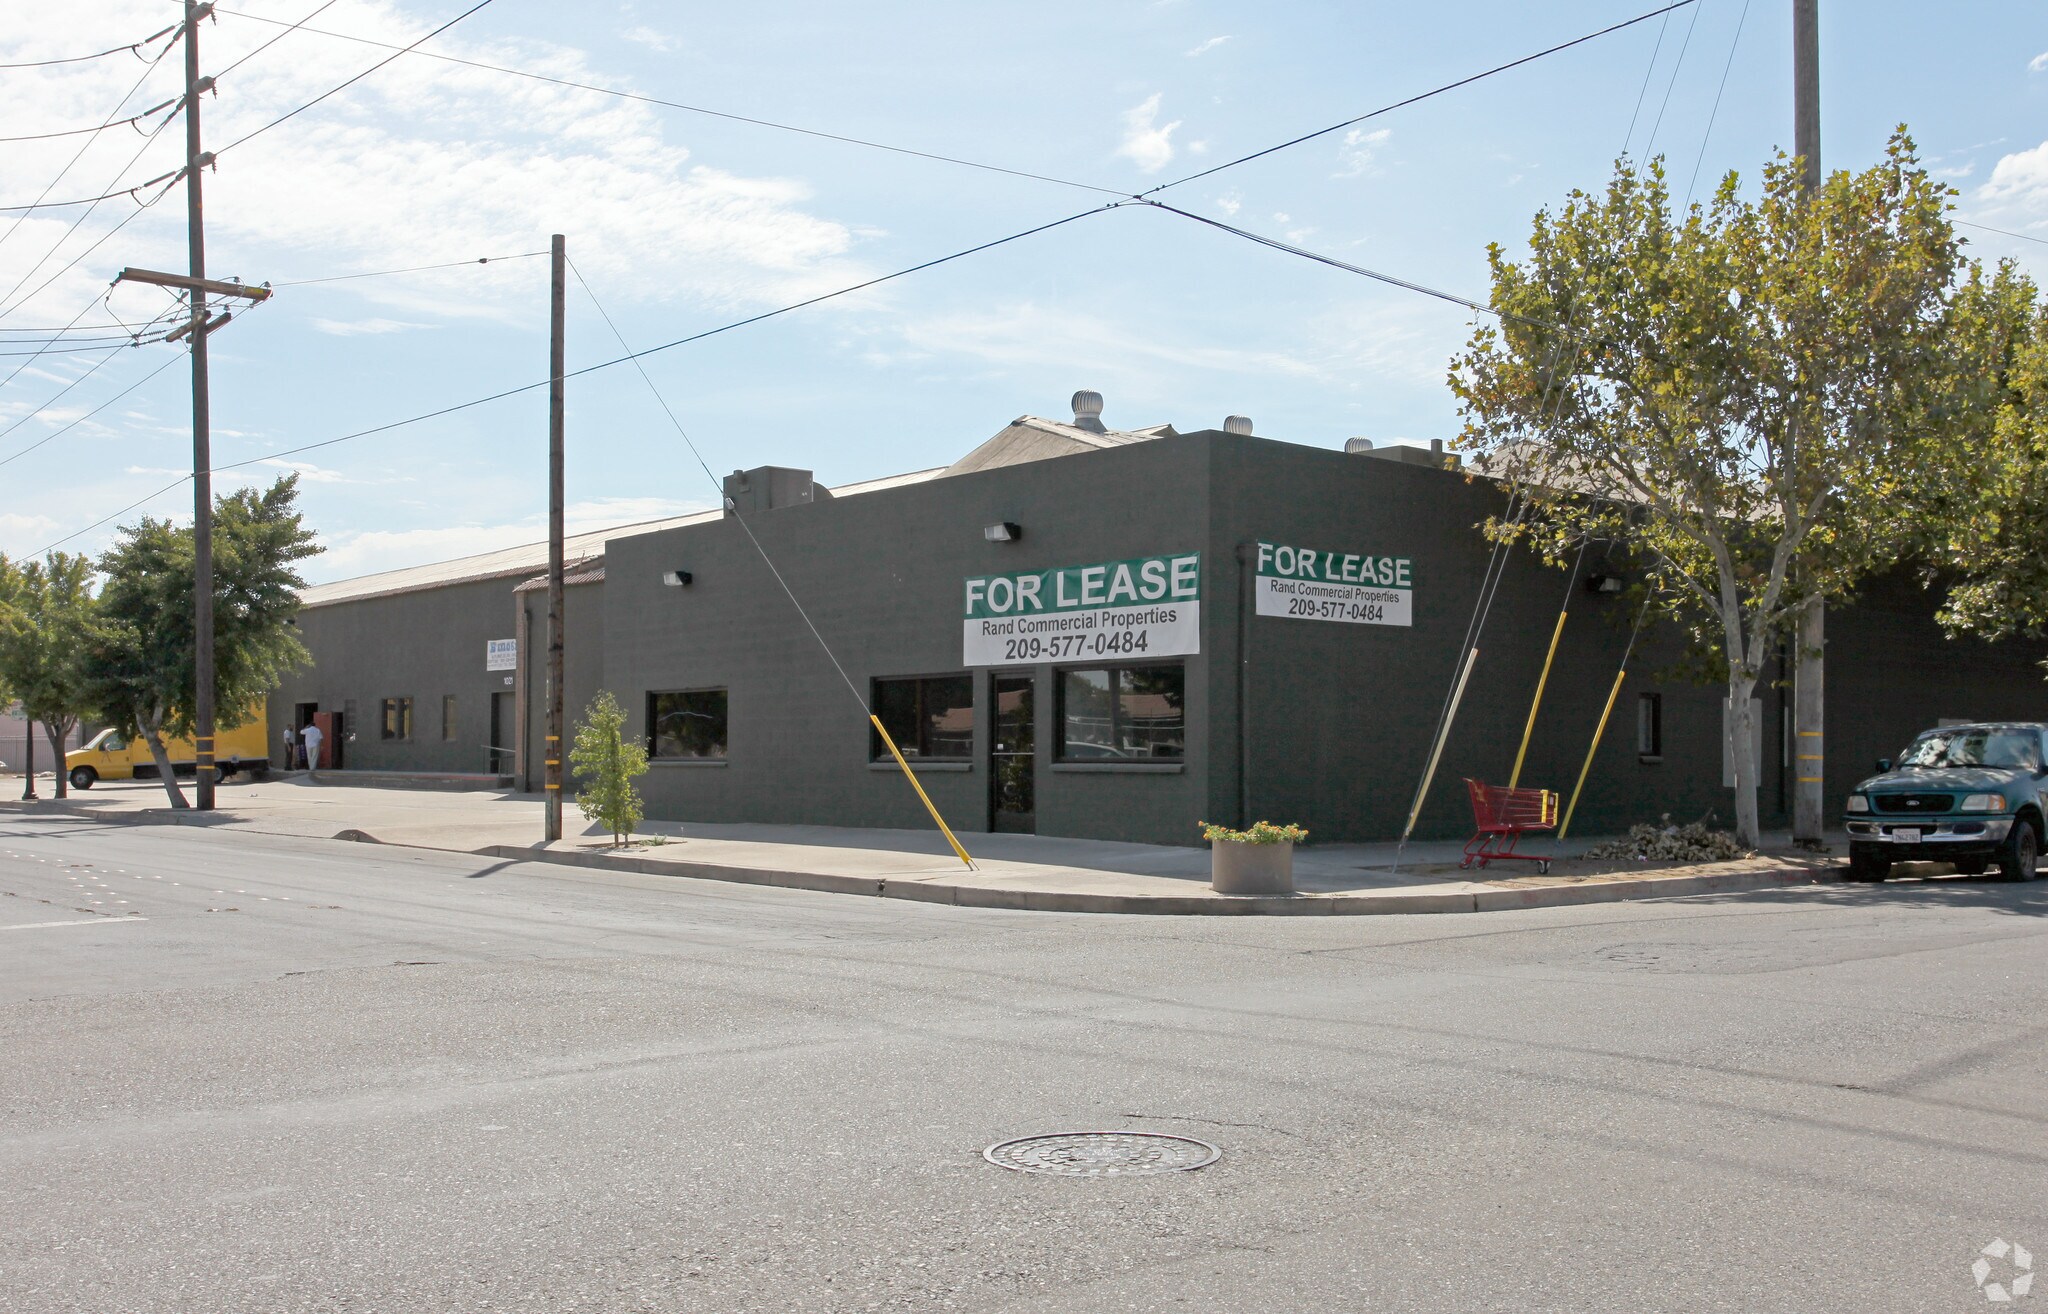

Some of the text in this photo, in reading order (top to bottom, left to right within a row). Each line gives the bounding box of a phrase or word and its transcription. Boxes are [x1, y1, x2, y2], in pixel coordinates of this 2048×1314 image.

[1258, 543, 1411, 586] FOR LEASE
[966, 556, 1197, 615] FOR LEASE
[1271, 580, 1399, 603] Rand Commercial Properties
[982, 608, 1177, 635] Rand Commercial Properties
[1289, 598, 1383, 621] 209-577-0484
[1005, 630, 1148, 660] 209-577-0484
